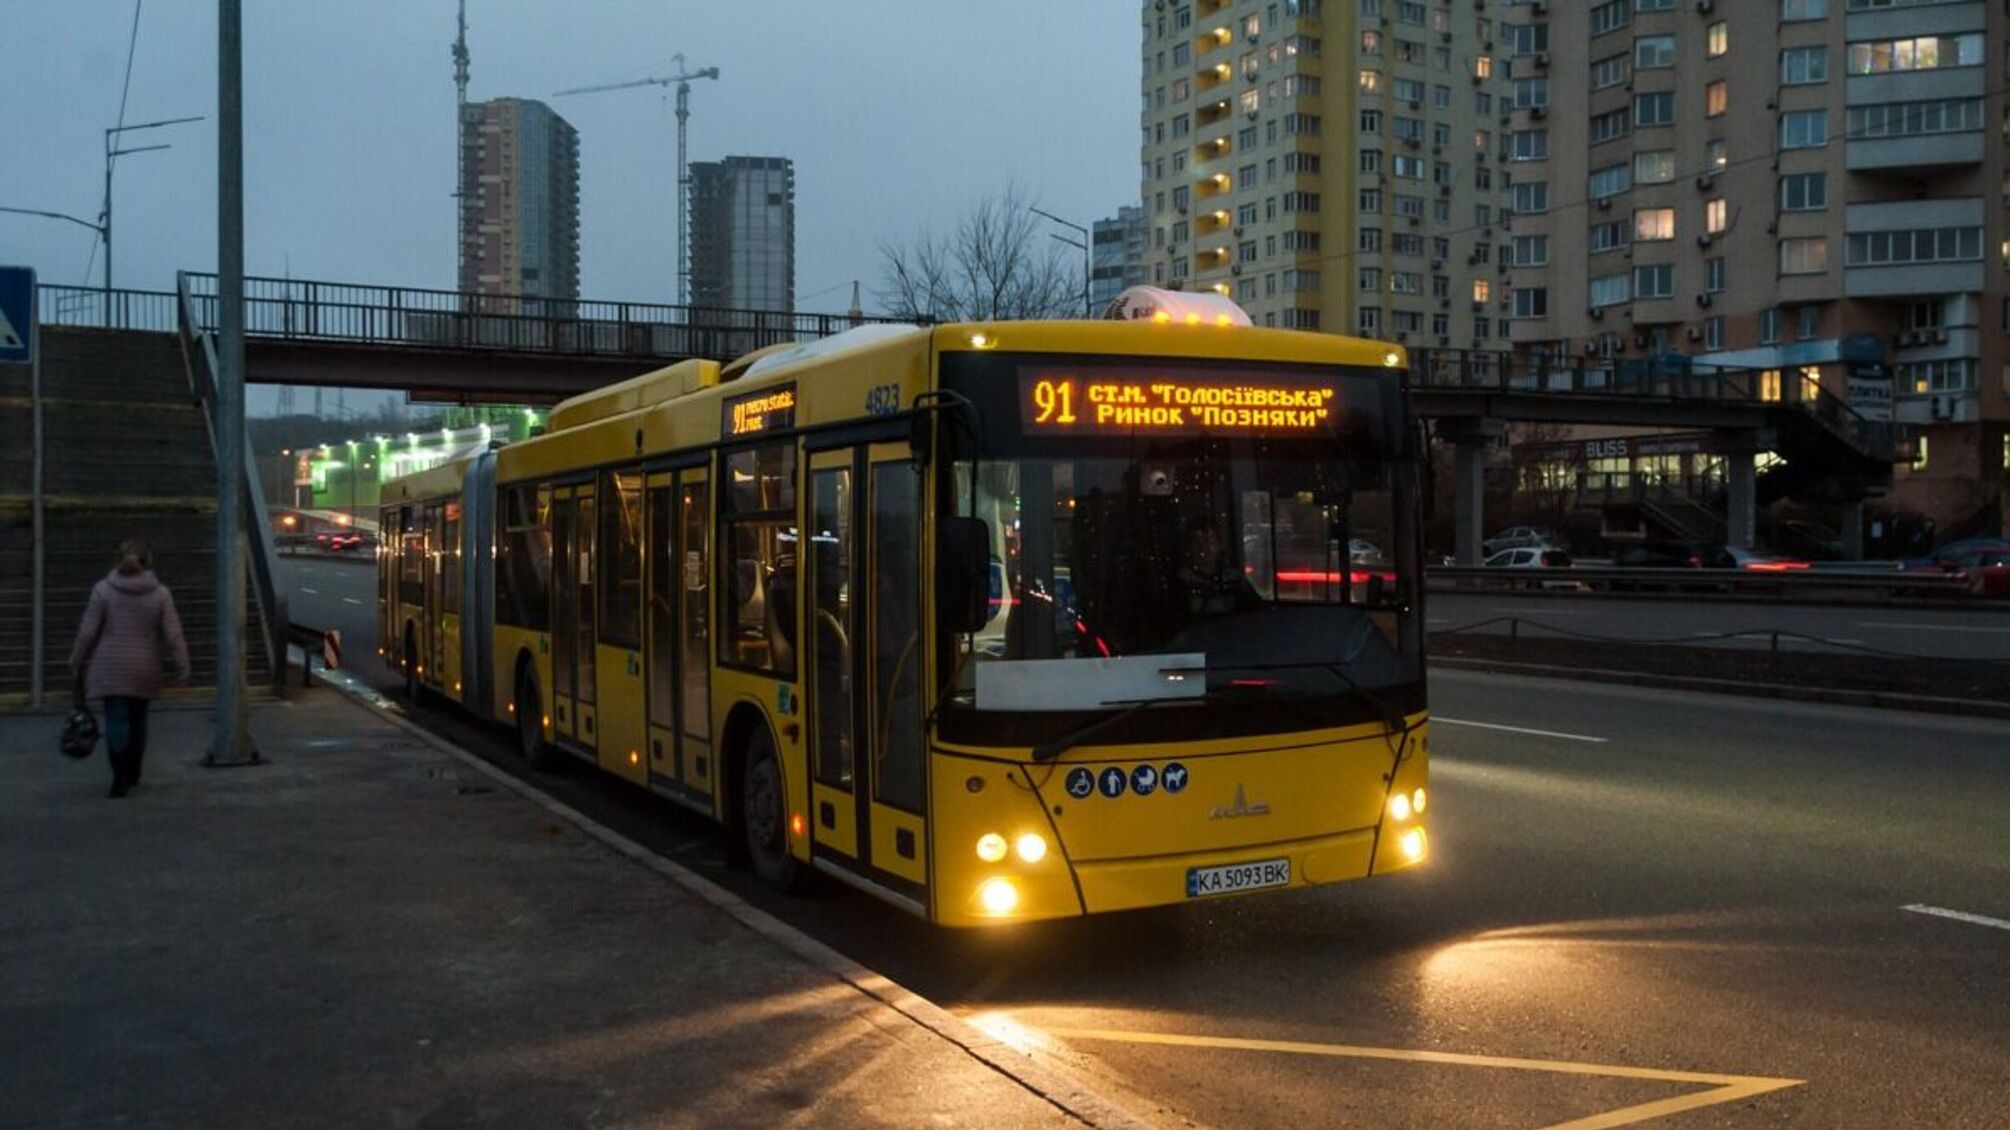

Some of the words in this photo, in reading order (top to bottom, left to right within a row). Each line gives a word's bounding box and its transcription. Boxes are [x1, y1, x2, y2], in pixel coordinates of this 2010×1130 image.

[1034, 380, 1076, 423] 91
[1151, 385, 1333, 407] "Голосіївська"
[1097, 404, 1184, 425] Ринок
[1190, 405, 1328, 427] "Позняки"
[1585, 439, 1628, 458] BLISS
[1199, 872, 1222, 892] KA
[1226, 866, 1262, 888] 5093
[1264, 863, 1287, 883] BK
